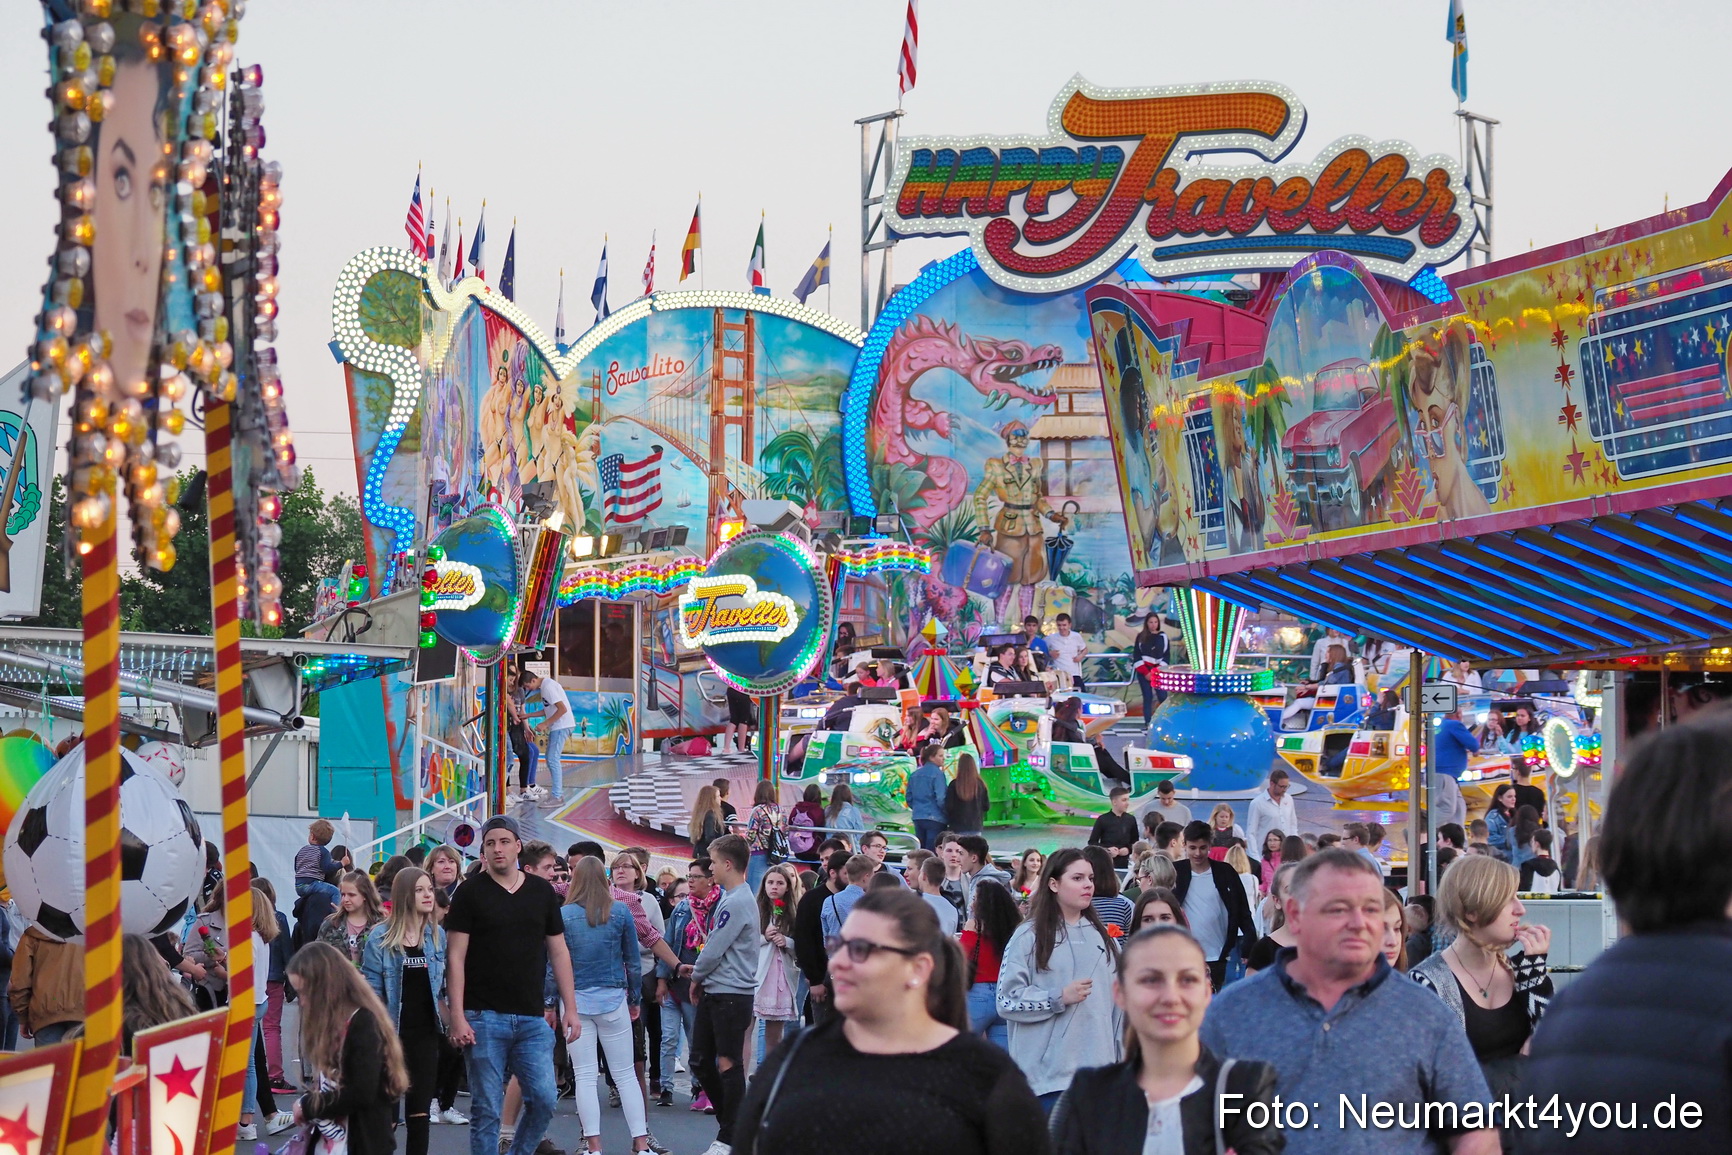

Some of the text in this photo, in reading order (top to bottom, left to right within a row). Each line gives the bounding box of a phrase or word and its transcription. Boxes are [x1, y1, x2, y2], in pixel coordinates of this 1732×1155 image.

[896, 90, 1462, 274] HAPPY Traveller
[606, 353, 685, 395] Sausalito
[424, 569, 476, 596] eller
[686, 584, 790, 638] Traveller
